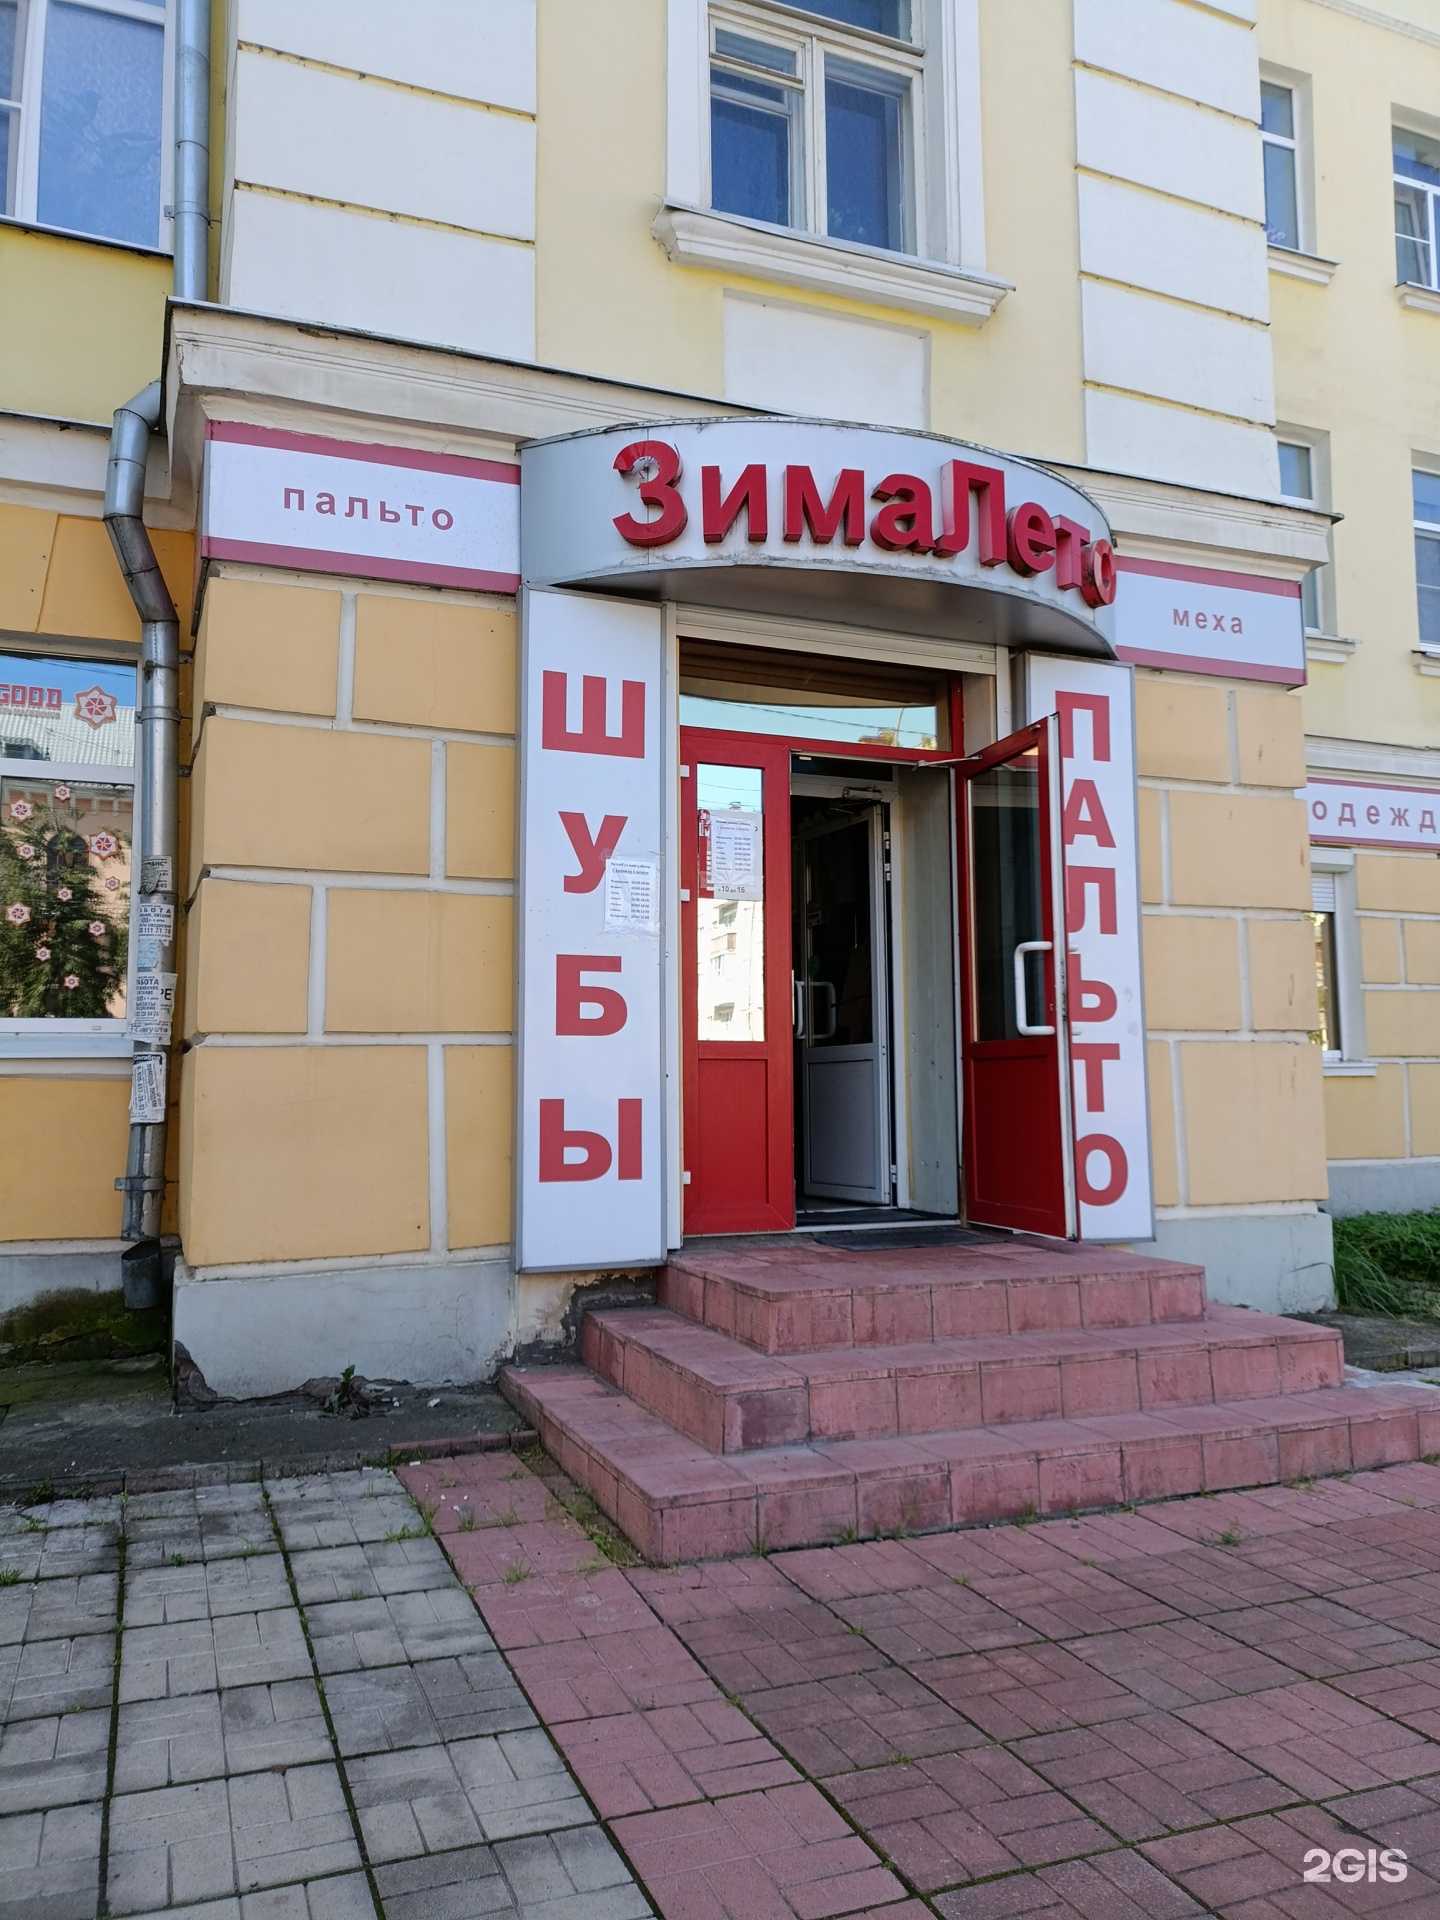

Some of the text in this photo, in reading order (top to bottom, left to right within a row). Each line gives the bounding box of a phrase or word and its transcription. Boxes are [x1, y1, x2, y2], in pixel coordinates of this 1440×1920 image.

[283, 487, 454, 531] пальто
[612, 440, 1117, 608] ЗимаЛето
[1172, 608, 1243, 635] меха
[1311, 800, 1437, 834] одежд
[538, 669, 647, 1183] ШУБЫ
[1055, 690, 1129, 1207] ПАЛЬТО
